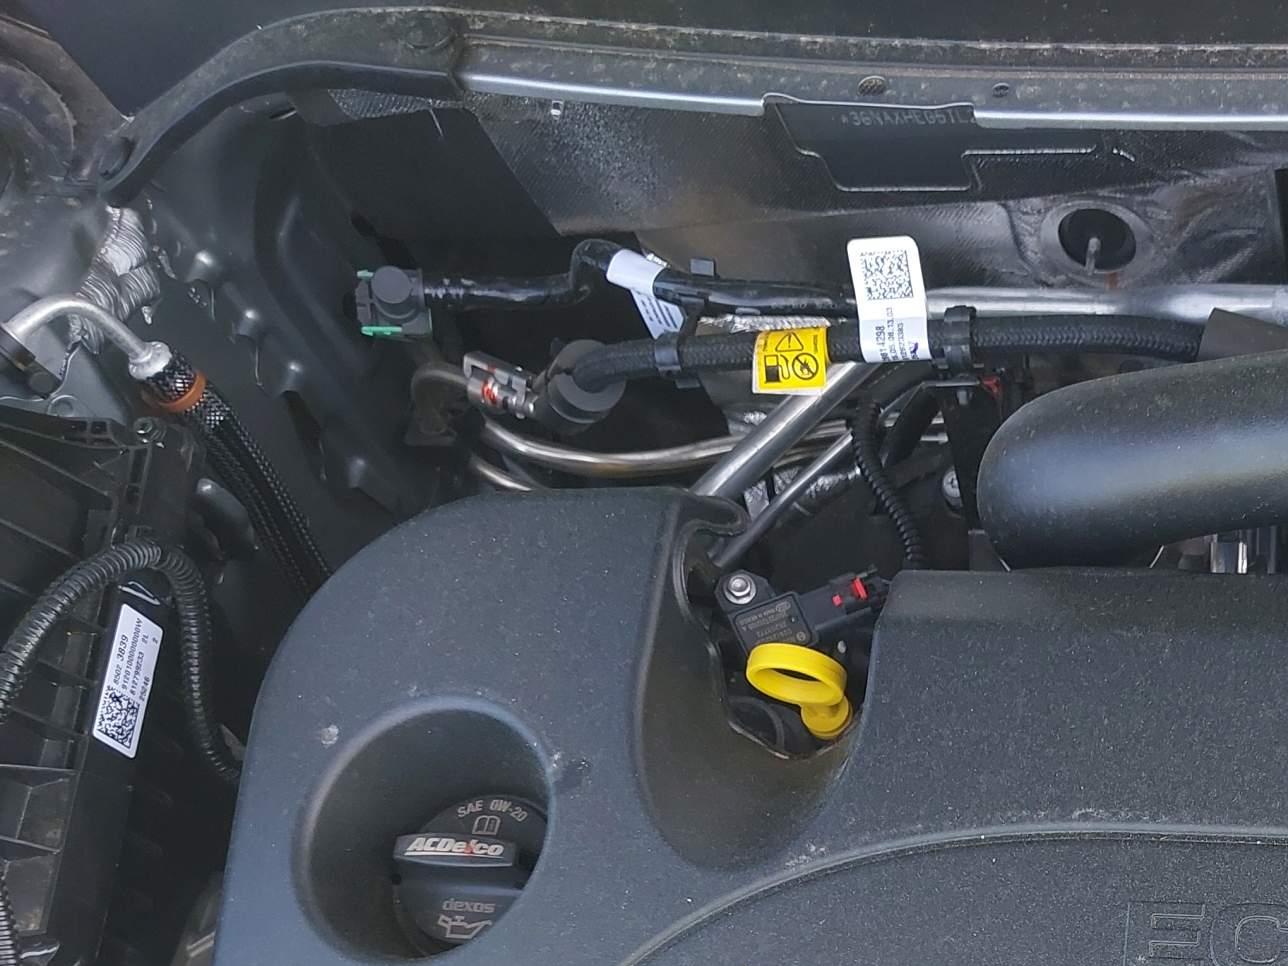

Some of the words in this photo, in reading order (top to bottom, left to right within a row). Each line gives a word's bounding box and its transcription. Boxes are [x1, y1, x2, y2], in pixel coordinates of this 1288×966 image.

[117, 634, 129, 661] 3839
[457, 800, 484, 817] SAE
[490, 799, 528, 821] 0W-20
[406, 837, 504, 856] ACDelco
[442, 898, 496, 913] dexos
